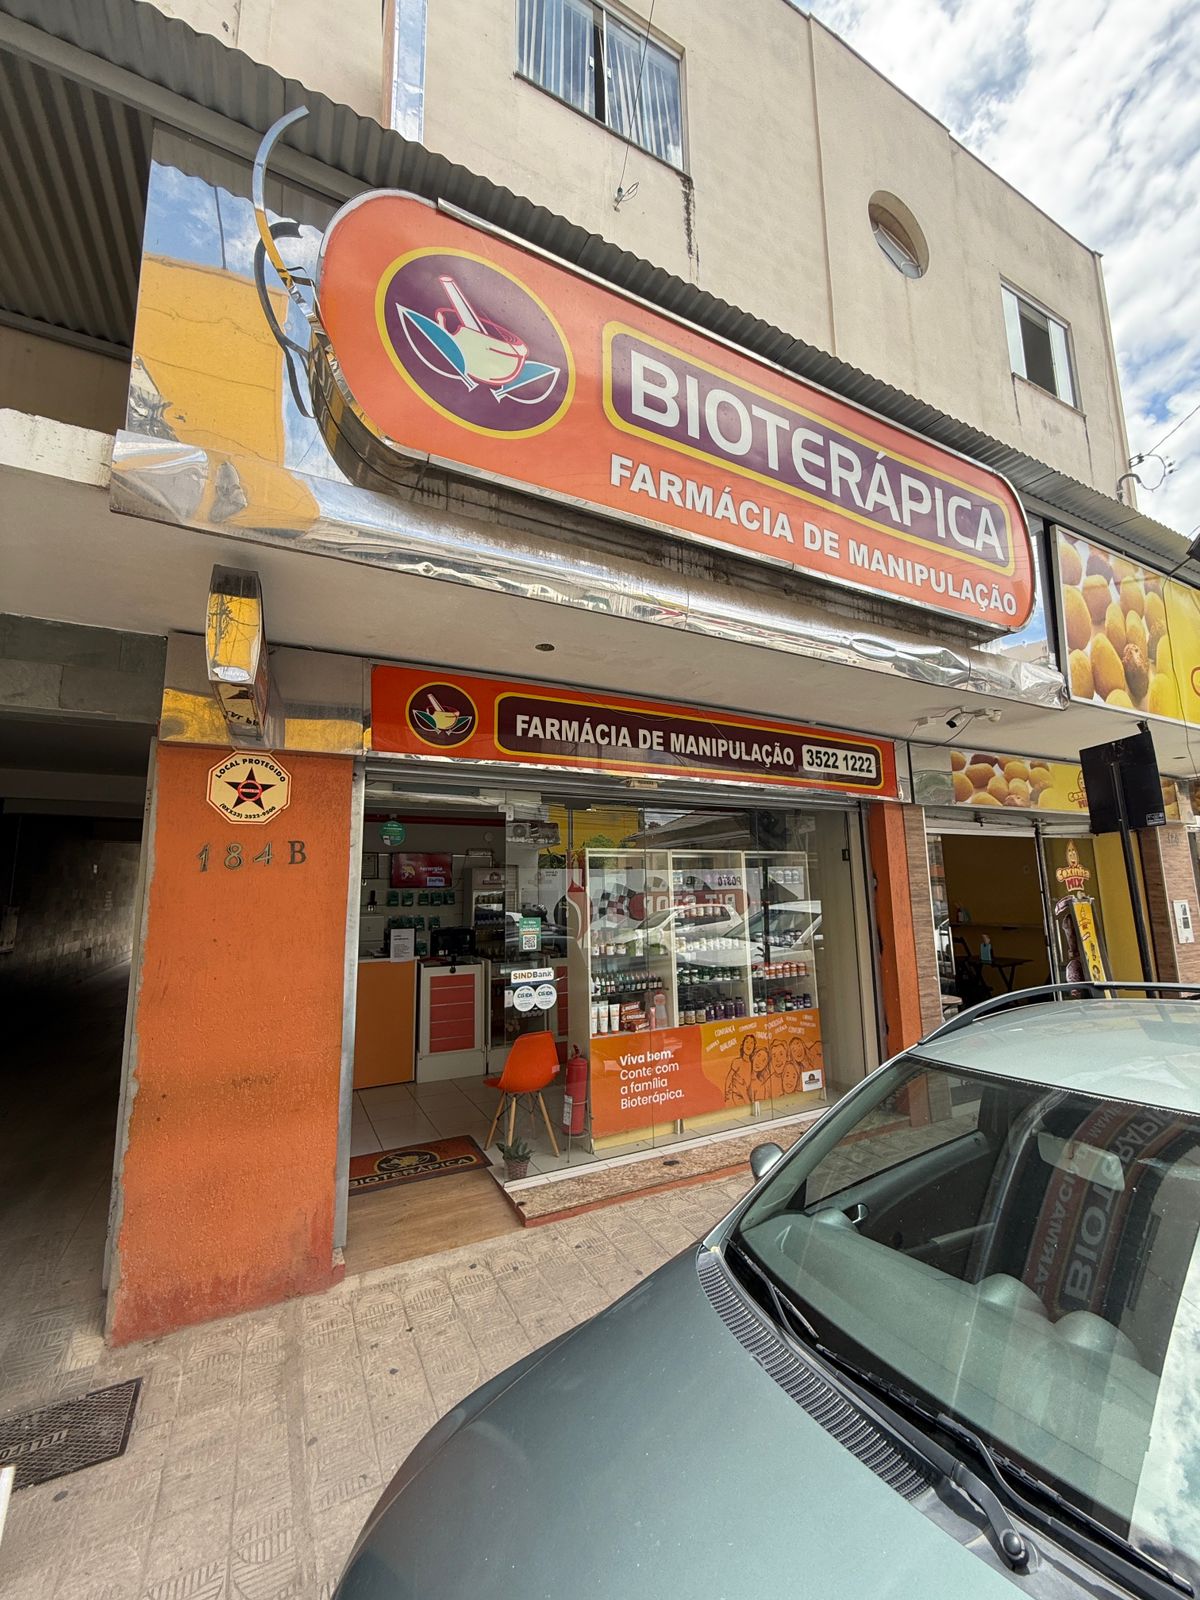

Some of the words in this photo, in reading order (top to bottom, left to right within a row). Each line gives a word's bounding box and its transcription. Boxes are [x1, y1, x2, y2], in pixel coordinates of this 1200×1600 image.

[629, 349, 1006, 561] BIOTERÁPICA
[610, 453, 794, 544] FARMÁCIA
[803, 524, 841, 560] DE
[848, 540, 1018, 617] MANIPULAÇÃO
[515, 714, 632, 748] FARMÁCIA
[638, 728, 664, 751] DE
[669, 733, 795, 768] MANIPULAÇÃO
[805, 747, 840, 769] 3522
[842, 752, 874, 775] 1222
[215, 760, 240, 779] LOCAL
[242, 758, 286, 782] PROTEGIDO
[197, 842, 273, 872] 184
[288, 840, 307, 865] B
[1066, 878, 1084, 890] MIX
[512, 971, 552, 980] SINDBank
[620, 1053, 645, 1067] Viva
[647, 1050, 674, 1064] bem.
[620, 1065, 652, 1081] Conte
[655, 1063, 679, 1076] com
[620, 1085, 628, 1095] a
[630, 1077, 668, 1094] família
[620, 1088, 685, 1110] Bioterápica.
